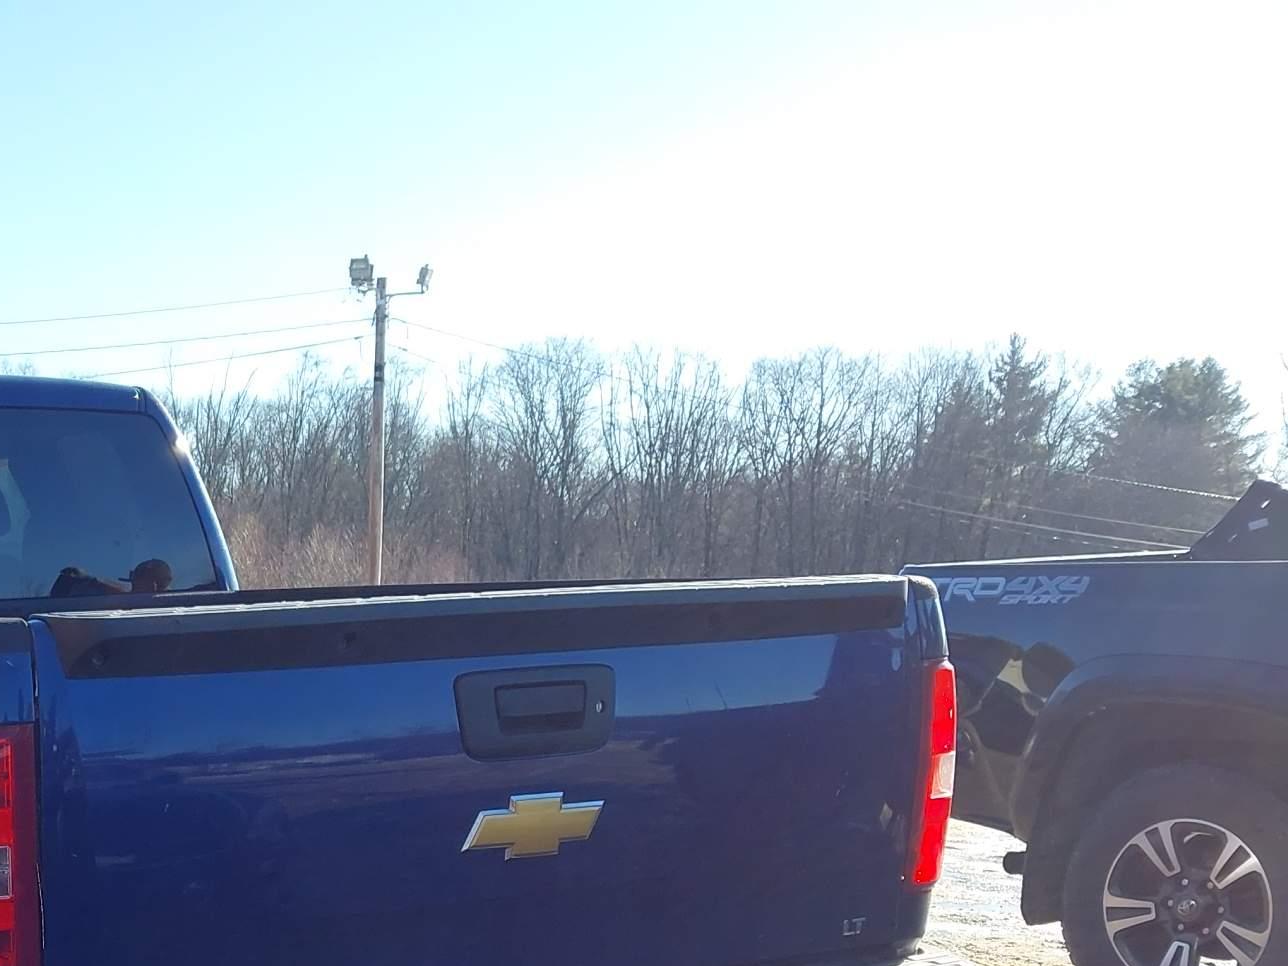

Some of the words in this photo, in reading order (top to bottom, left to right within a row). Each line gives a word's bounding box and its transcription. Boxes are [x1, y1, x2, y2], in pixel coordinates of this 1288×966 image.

[932, 576, 1007, 602] TRD
[998, 594, 1078, 605] SPORT
[843, 917, 866, 936] LT
